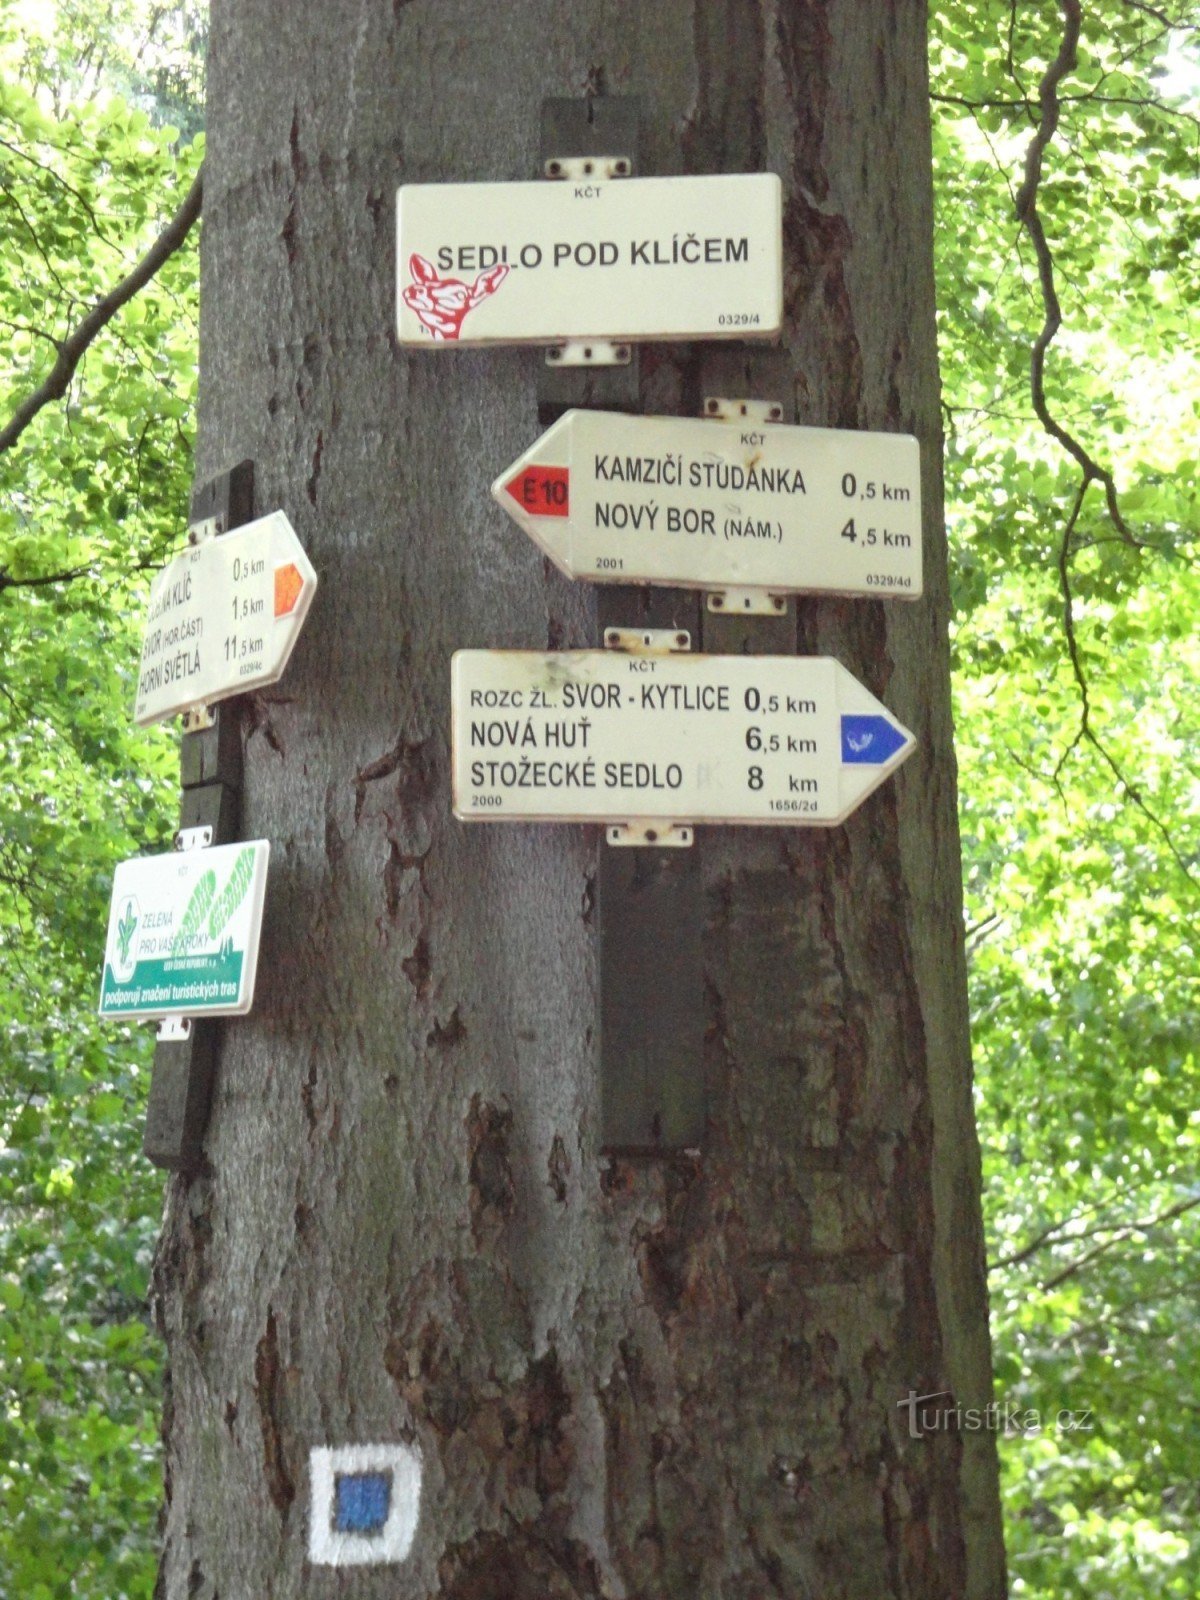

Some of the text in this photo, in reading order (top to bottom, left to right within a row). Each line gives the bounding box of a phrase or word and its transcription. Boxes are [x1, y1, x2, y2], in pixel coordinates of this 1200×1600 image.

[574, 187, 602, 199] KČT
[437, 232, 749, 271] SEDLO POD KLÍČEM
[718, 314, 760, 326] 0329/4
[740, 433, 766, 446] KČT
[595, 453, 682, 486] KAMZIČÍ
[841, 472, 876, 500] 0,5
[883, 483, 910, 501] km
[523, 477, 536, 504] E
[595, 500, 911, 548] NOVÝ BOR (NÁM.) 4,5 km
[596, 557, 624, 569] 2001
[172, 571, 192, 607] KLÍČ
[233, 557, 249, 581] 0,5
[250, 560, 264, 578] km
[866, 574, 911, 588] 0329/4d
[250, 599, 264, 614] km
[139, 657, 163, 697] HORNÍ
[164, 641, 201, 684] SVĚTLÁ
[249, 638, 263, 653] km
[629, 660, 657, 672] KČT
[470, 690, 523, 708] ROZC
[529, 686, 557, 708] ŽL.
[563, 683, 621, 708] SVOR
[641, 685, 729, 711] KYTLICE
[744, 687, 779, 715] 0,5
[787, 696, 816, 713] km
[471, 716, 817, 754] NOVÁ HUŤ 6,5 km
[471, 756, 818, 792] STOŽECKÉ SEDLO 8 km
[472, 796, 502, 806] 2000
[769, 800, 818, 812] 1656/2d
[220, 981, 237, 996] tras
